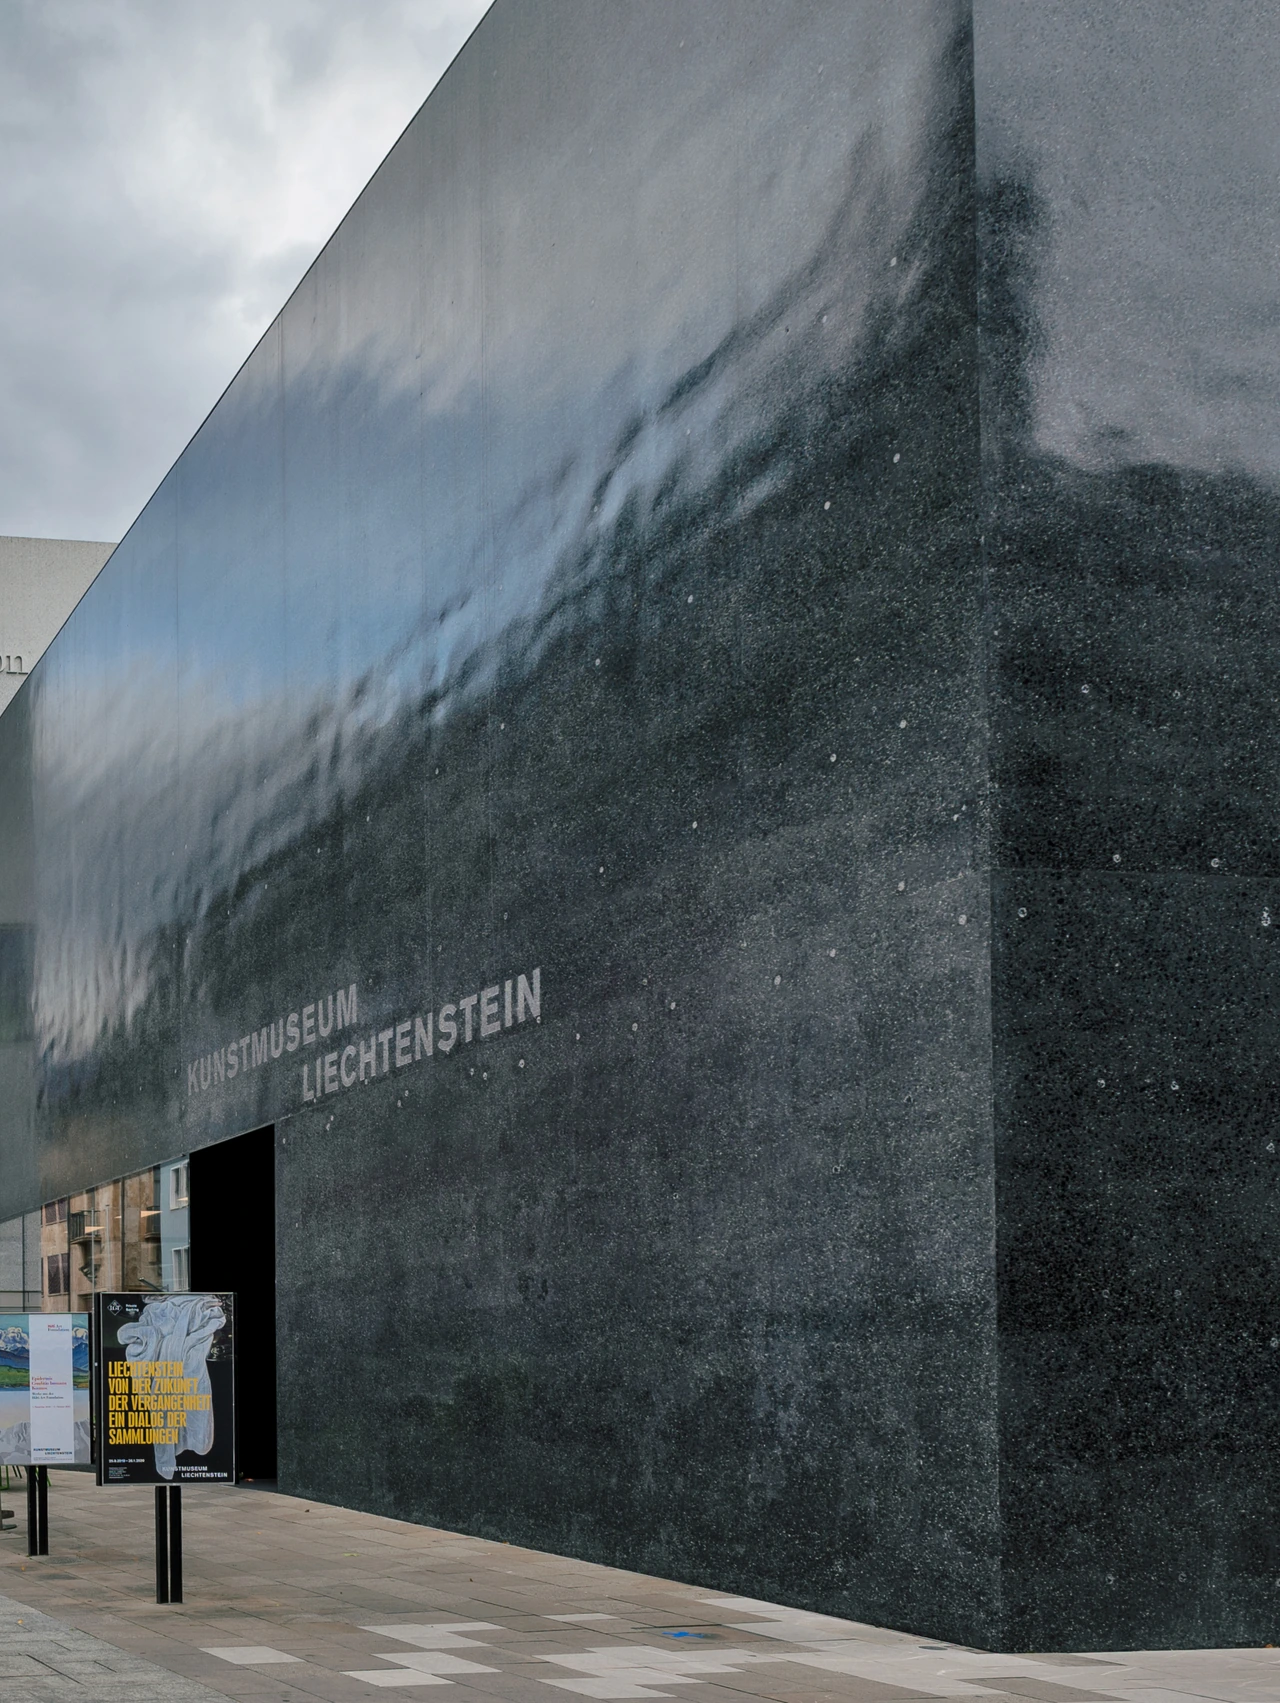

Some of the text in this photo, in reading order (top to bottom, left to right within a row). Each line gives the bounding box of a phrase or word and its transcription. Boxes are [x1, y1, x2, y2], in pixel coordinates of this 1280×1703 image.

[187, 983, 358, 1096] KUNSTMUSEUM
[302, 967, 541, 1101] LIECHTENSTEIN
[108, 1361, 184, 1377] LIECHTENSTEIN
[108, 1378, 198, 1394] VON DER ZUKUNFT
[108, 1395, 212, 1411] DER VERGANGENHEIT
[108, 1411, 187, 1427] EIN DIALOG DER
[108, 1428, 179, 1444] SAMMLUNGEN
